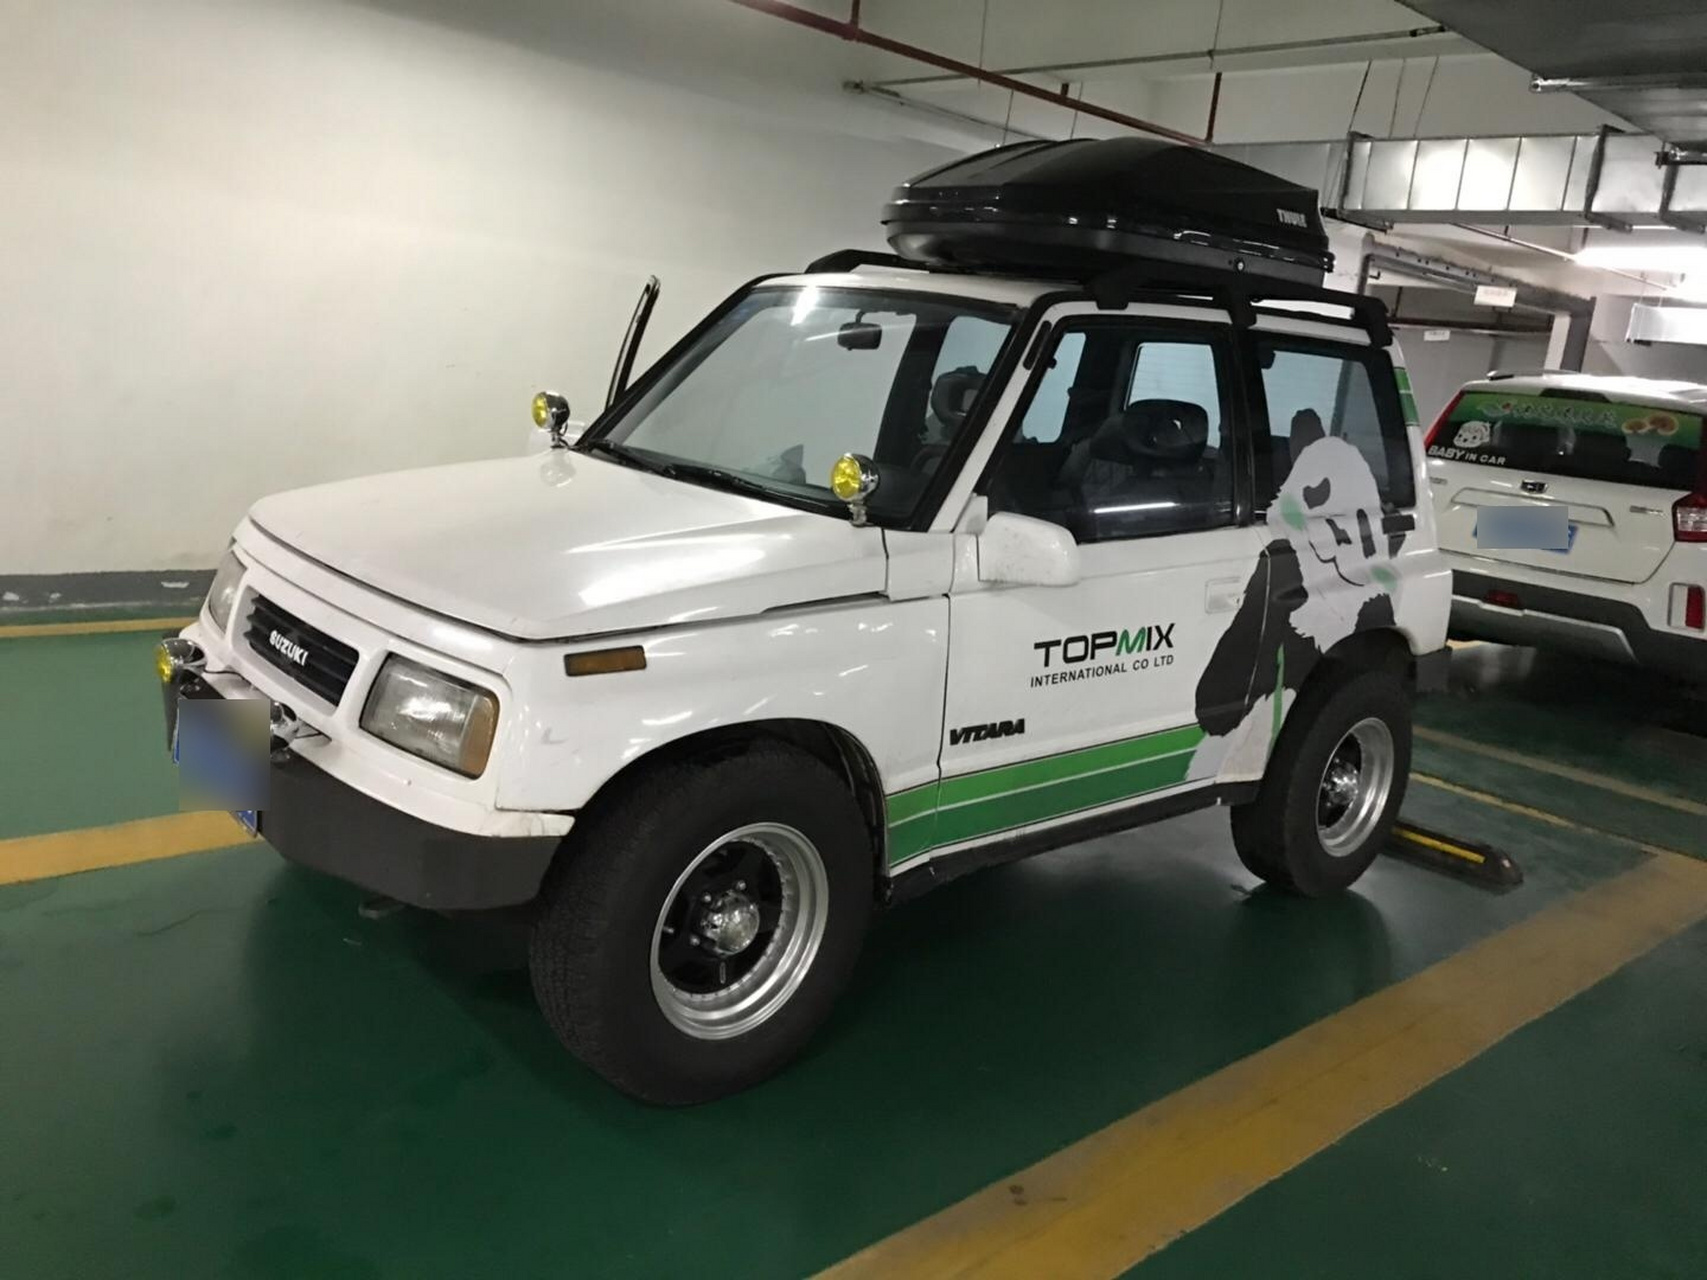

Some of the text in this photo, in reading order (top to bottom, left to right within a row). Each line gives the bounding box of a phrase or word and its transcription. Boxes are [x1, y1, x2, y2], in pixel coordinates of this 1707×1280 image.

[1428, 445, 1506, 466] BABY IN CAR
[269, 630, 309, 666] SUZUKI
[1034, 623, 1175, 668] TOPMIX
[1030, 654, 1174, 688] INTERNATIONAL CO LTD
[949, 718, 1025, 746] VITARA
